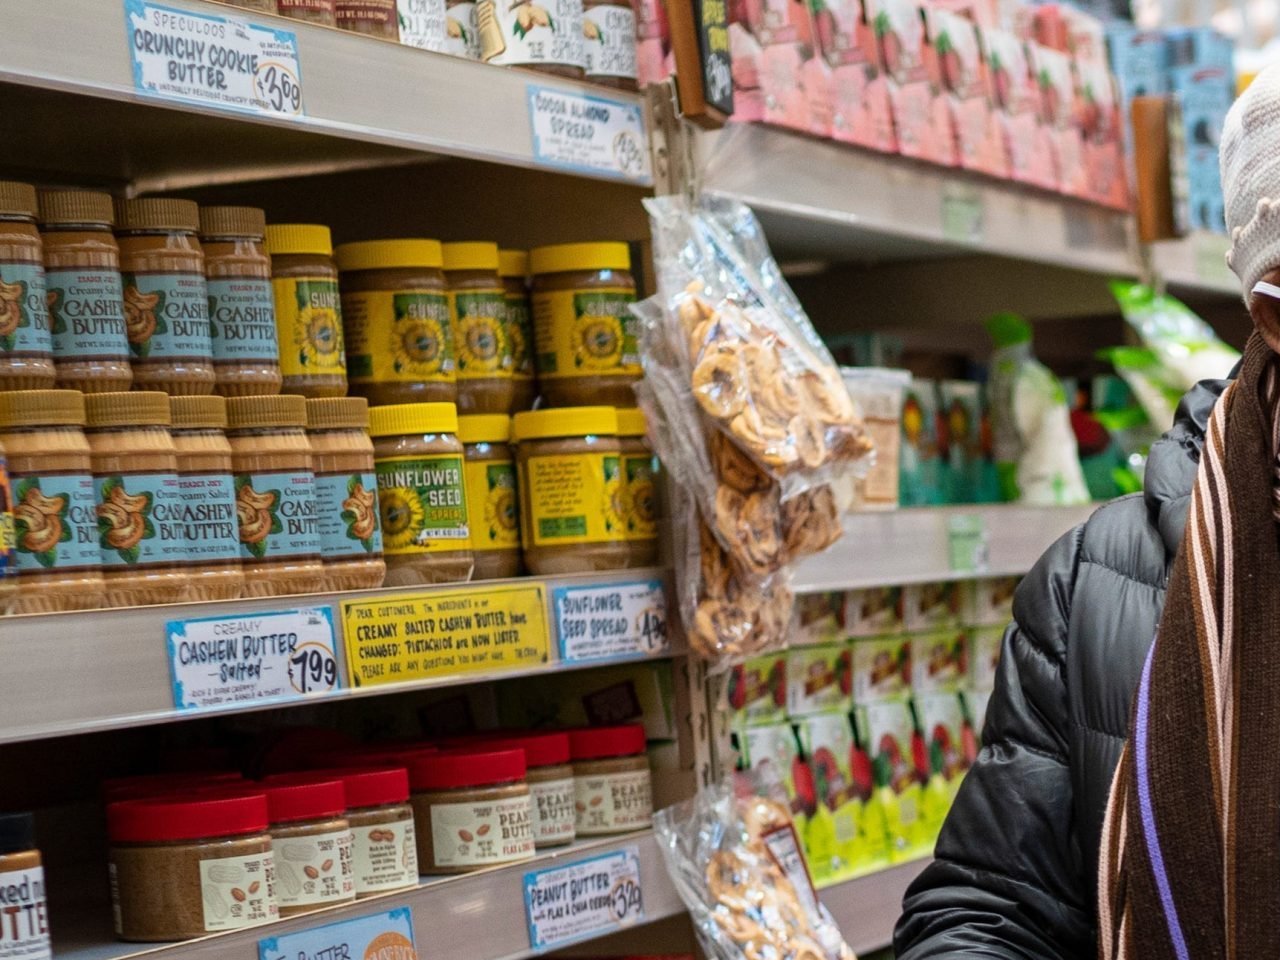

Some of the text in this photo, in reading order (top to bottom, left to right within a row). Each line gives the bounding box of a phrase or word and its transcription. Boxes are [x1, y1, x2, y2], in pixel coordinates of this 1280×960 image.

[153, 11, 226, 39] SPECULOOS
[134, 28, 205, 64] CRUNCHY
[208, 44, 260, 76] COOKIE
[168, 60, 228, 90] BUTTER
[257, 66, 300, 113] $3.69
[377, 468, 459, 489] SUNFLOWER
[180, 491, 207, 502] reamy
[430, 489, 461, 507] SEED
[183, 504, 234, 521] ASHEW
[185, 523, 238, 542] UTTER
[563, 593, 623, 615] SUNFLOWER
[213, 621, 262, 636] CREAMY
[357, 622, 398, 642] CREAMY
[405, 618, 436, 636] SALTED
[439, 615, 472, 633] CASHEW
[474, 611, 507, 628] BUTTER
[562, 617, 628, 640] SEED SPREAD
[179, 632, 298, 666] CASHEW BUTTER
[359, 644, 401, 660] CHANGED:
[405, 637, 453, 655] PISTACHIOS
[472, 633, 490, 648] NOW
[407, 658, 419, 672] ANY
[499, 810, 529, 827] PEAN
[502, 823, 531, 840] BUTT
[531, 881, 568, 910] PEANUT
[570, 871, 610, 900] BUTTER
